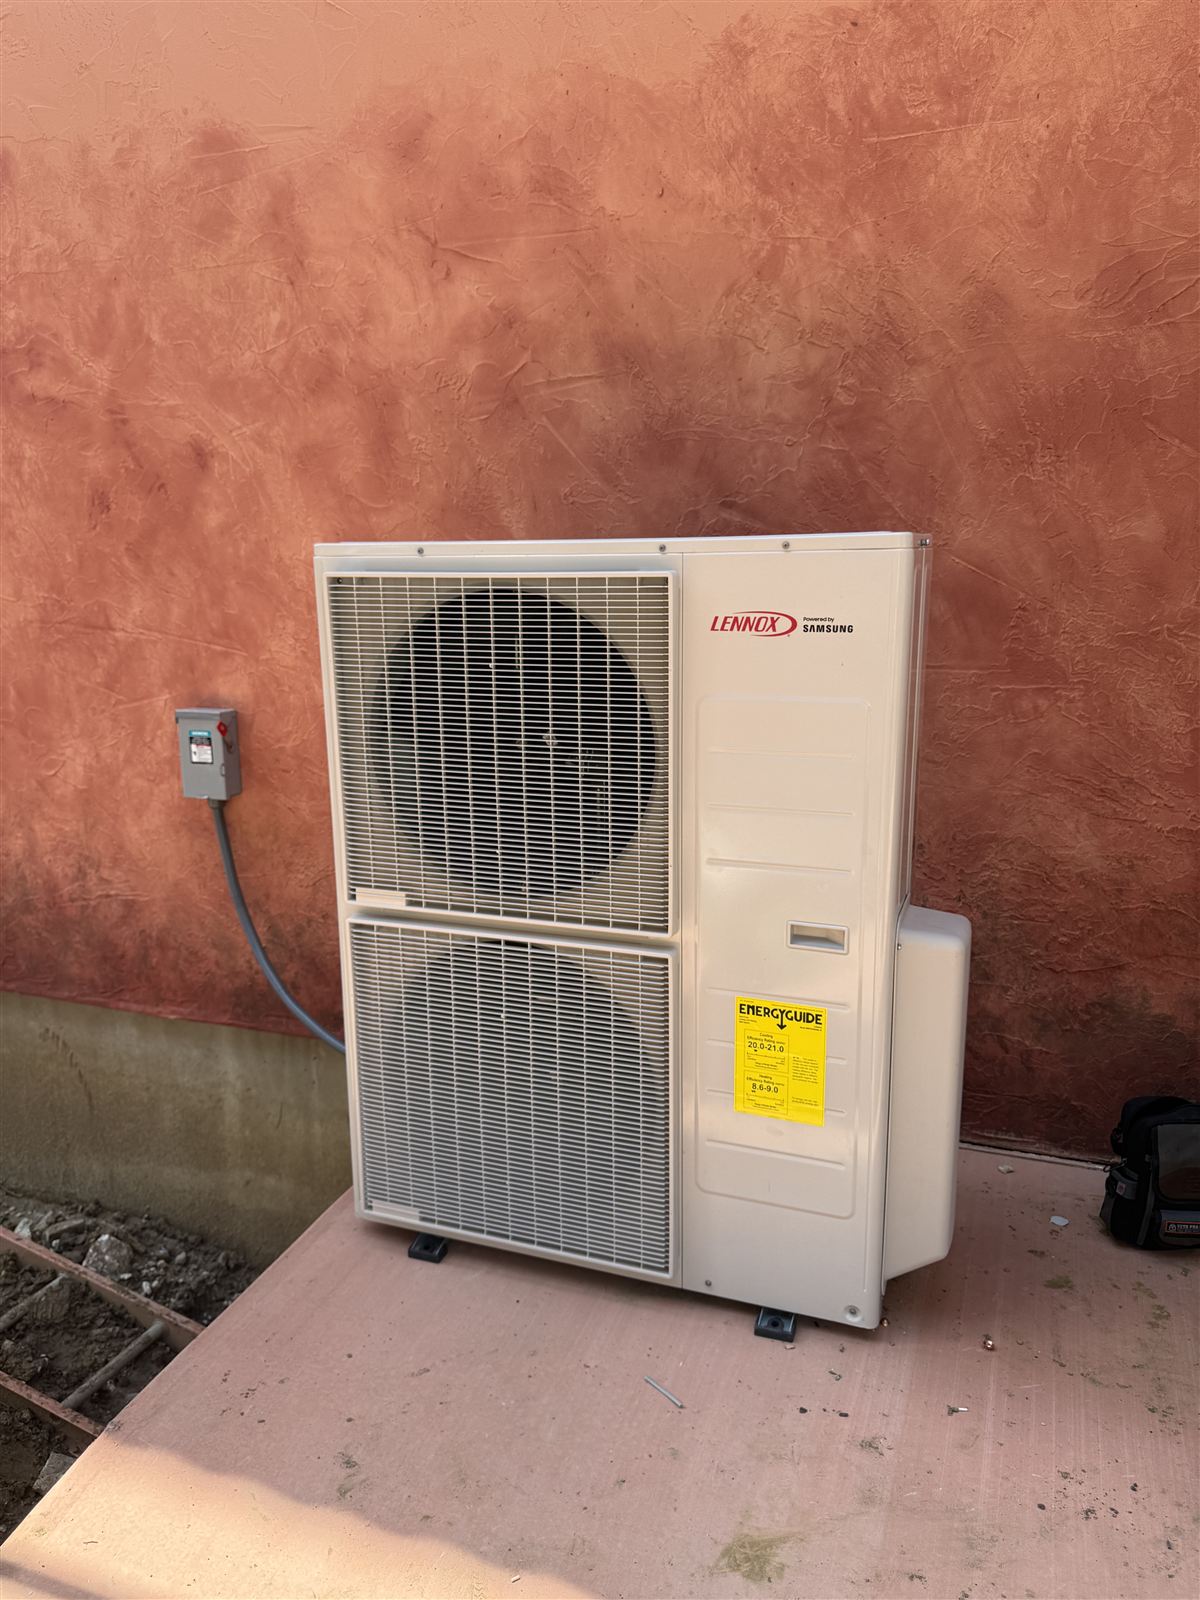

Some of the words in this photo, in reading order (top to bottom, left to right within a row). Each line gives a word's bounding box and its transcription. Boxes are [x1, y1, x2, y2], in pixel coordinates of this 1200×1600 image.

[710, 616, 780, 632] LENNOX
[803, 624, 853, 633] SAMSUNG
[739, 1004, 823, 1027] ENERGYGUIDE
[748, 1041, 784, 1052] 20.0-21.0
[752, 1083, 778, 1093] 8.6-9.0
